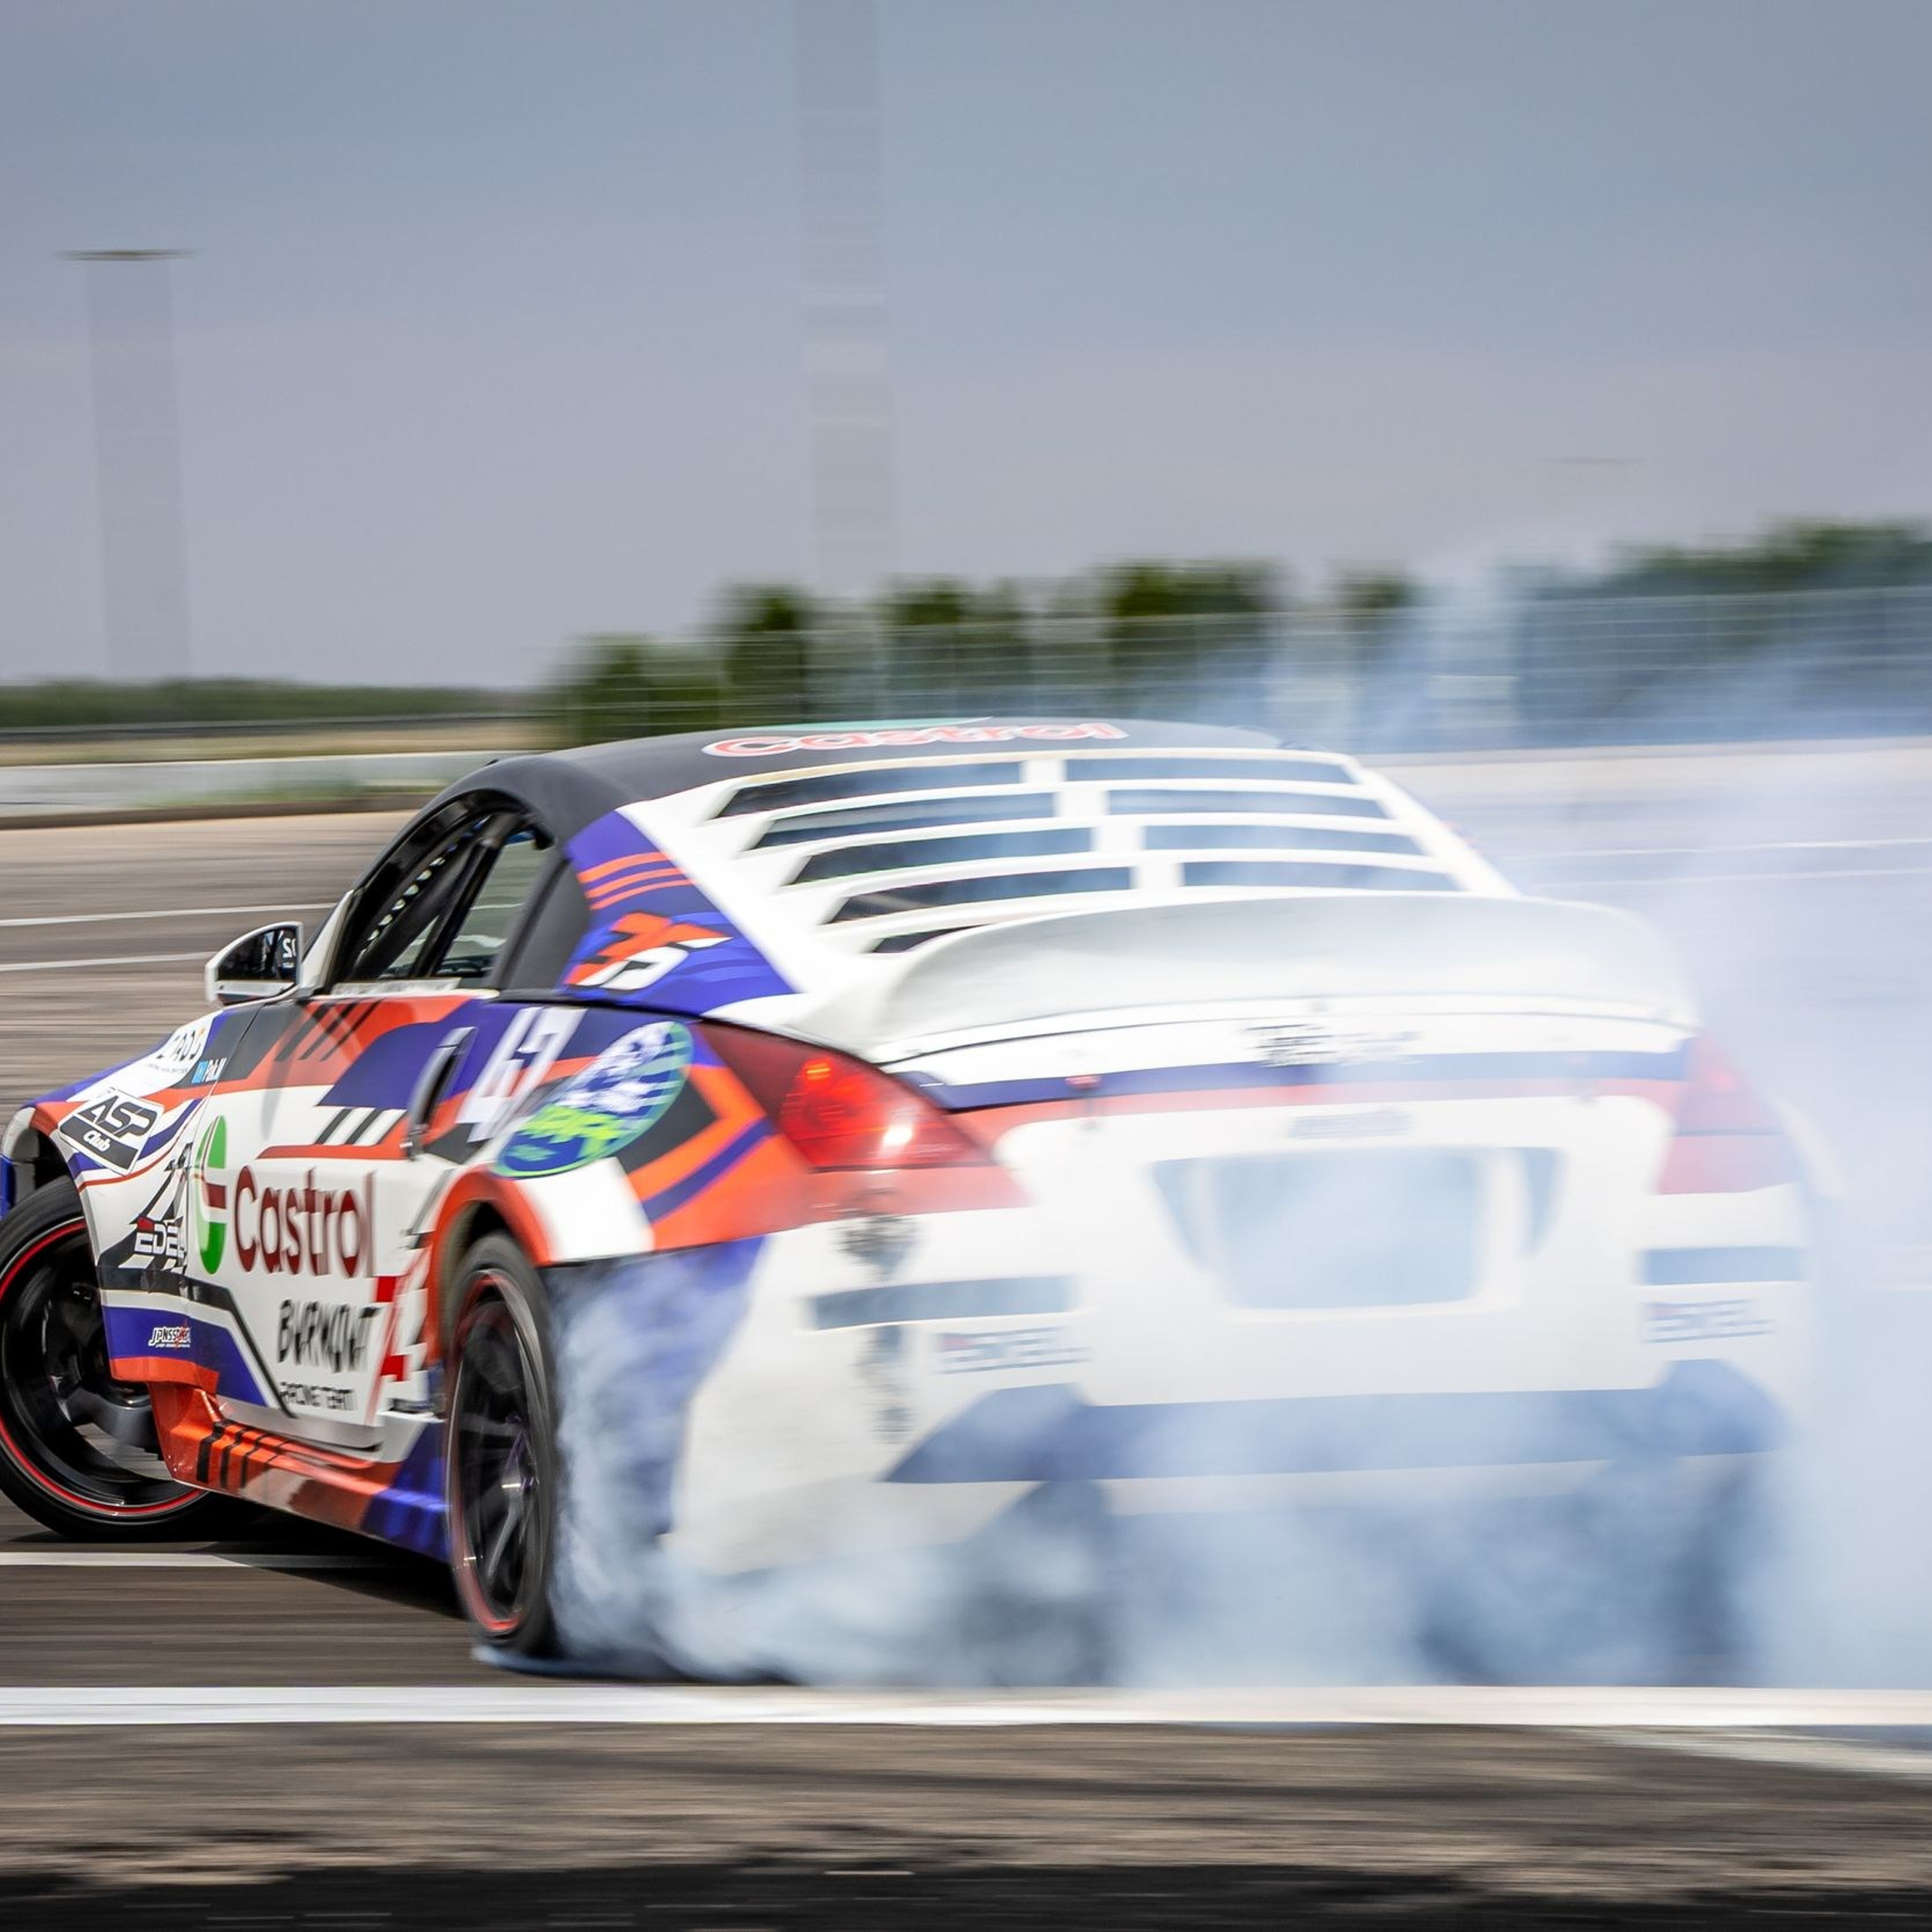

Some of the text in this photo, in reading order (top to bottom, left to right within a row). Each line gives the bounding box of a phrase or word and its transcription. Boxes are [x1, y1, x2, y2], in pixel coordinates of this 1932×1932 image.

[703, 722, 1129, 757] Castrol
[77, 1095, 158, 1139] ASP
[83, 1130, 111, 1152] Club
[234, 1165, 377, 1278] Castrol
